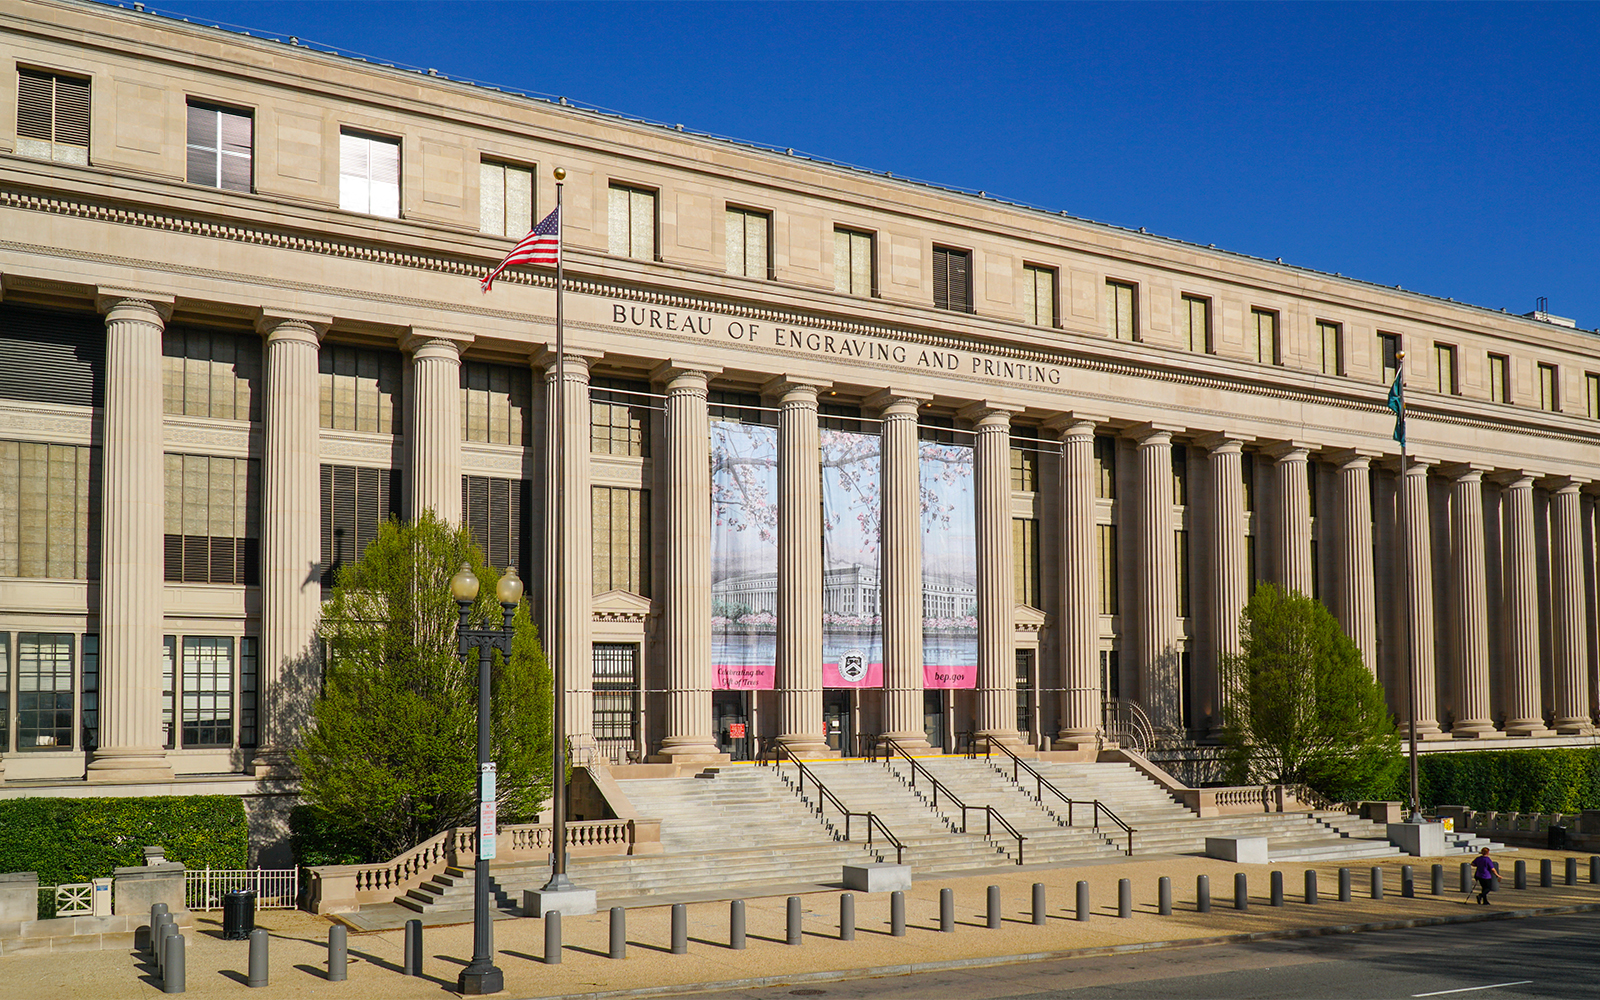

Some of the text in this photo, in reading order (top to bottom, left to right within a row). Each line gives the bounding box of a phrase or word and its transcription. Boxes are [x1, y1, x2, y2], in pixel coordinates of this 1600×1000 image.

[613, 304, 1060, 384] BUREAU OF ENGRAVING AND PRINTING
[718, 668, 754, 677] Celebrating
[935, 672, 965, 683] bep.gov
